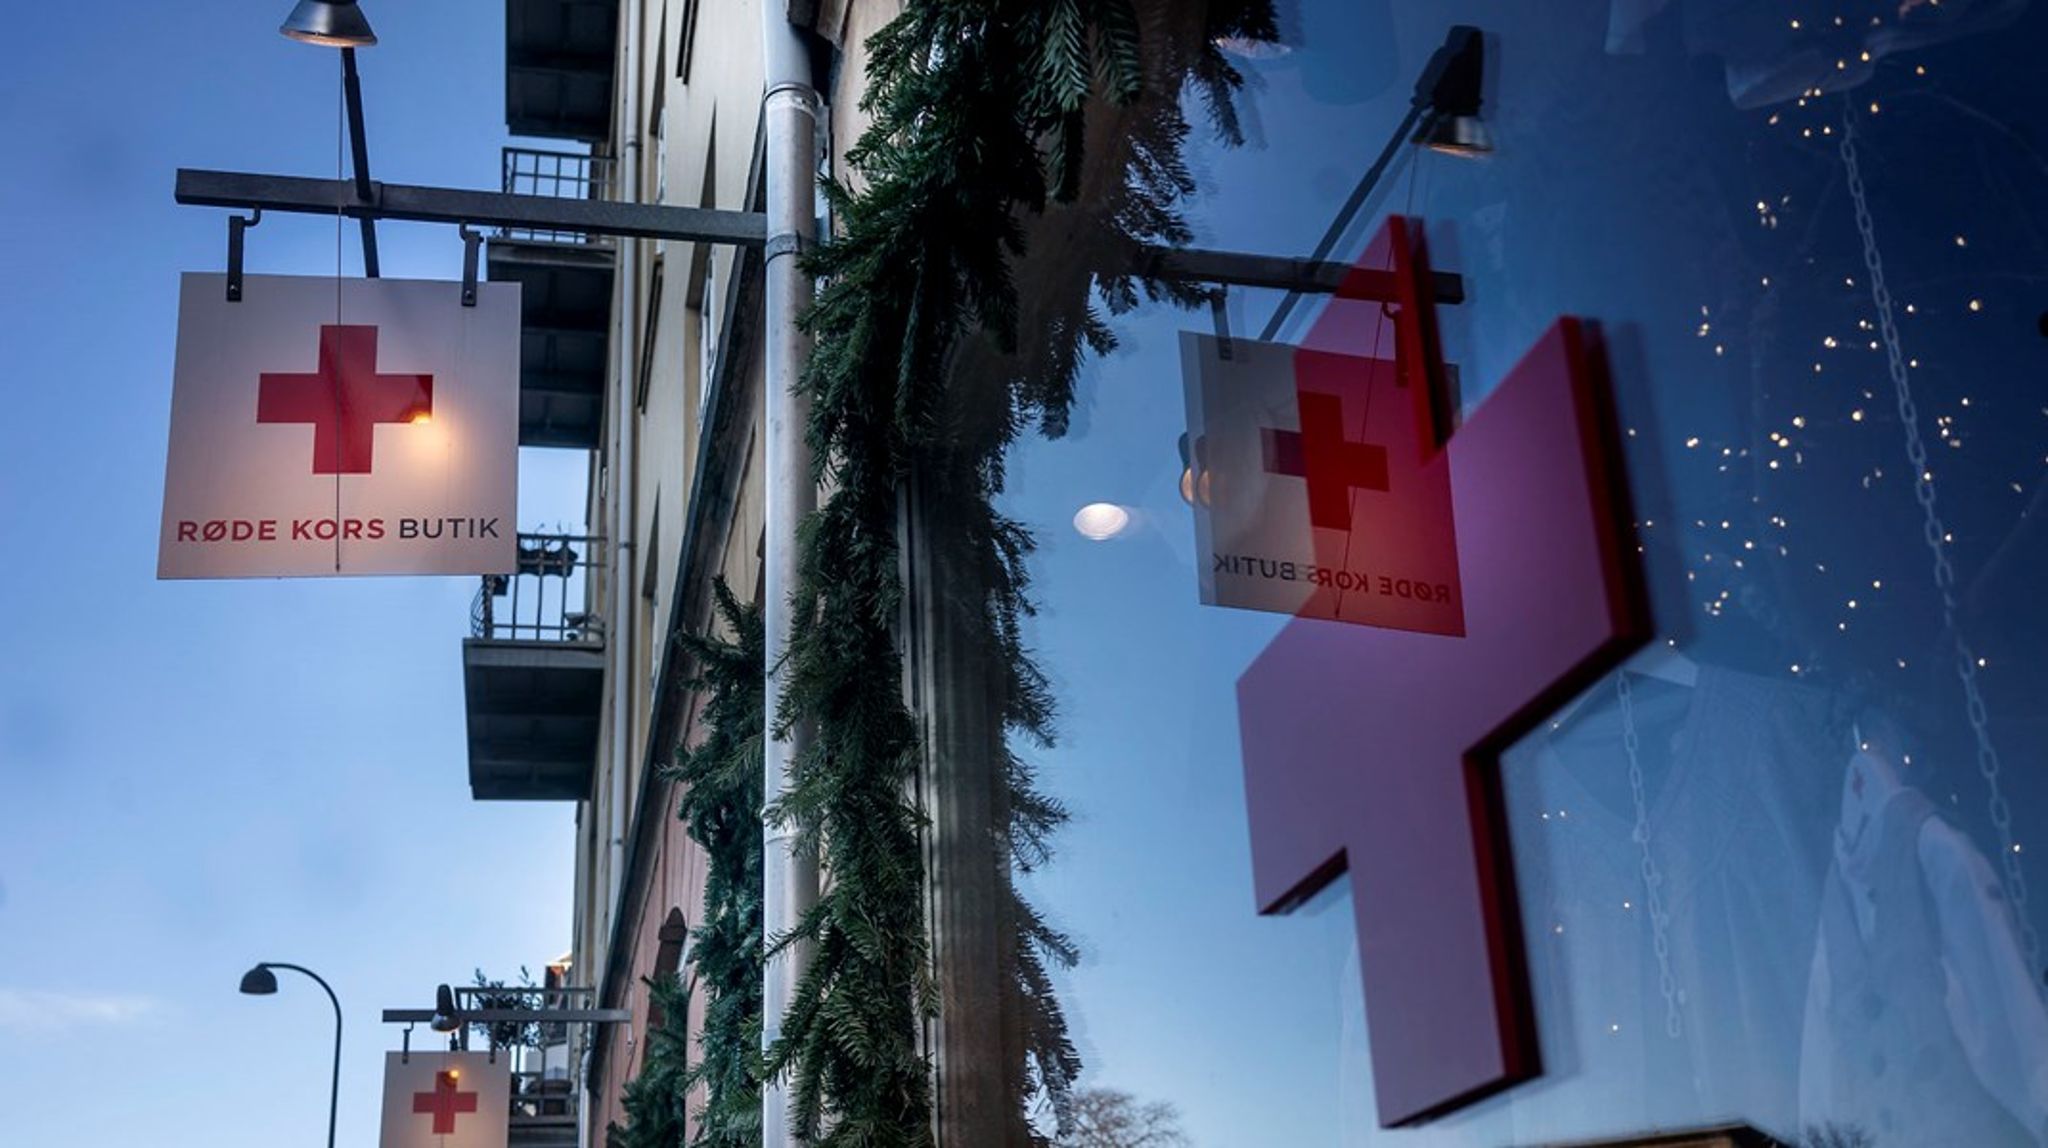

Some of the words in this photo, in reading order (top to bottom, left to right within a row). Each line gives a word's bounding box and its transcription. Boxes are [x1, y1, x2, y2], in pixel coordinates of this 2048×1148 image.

[177, 520, 277, 542] RØDE
[292, 518, 386, 541] KORS
[399, 517, 499, 539] BUTIK
